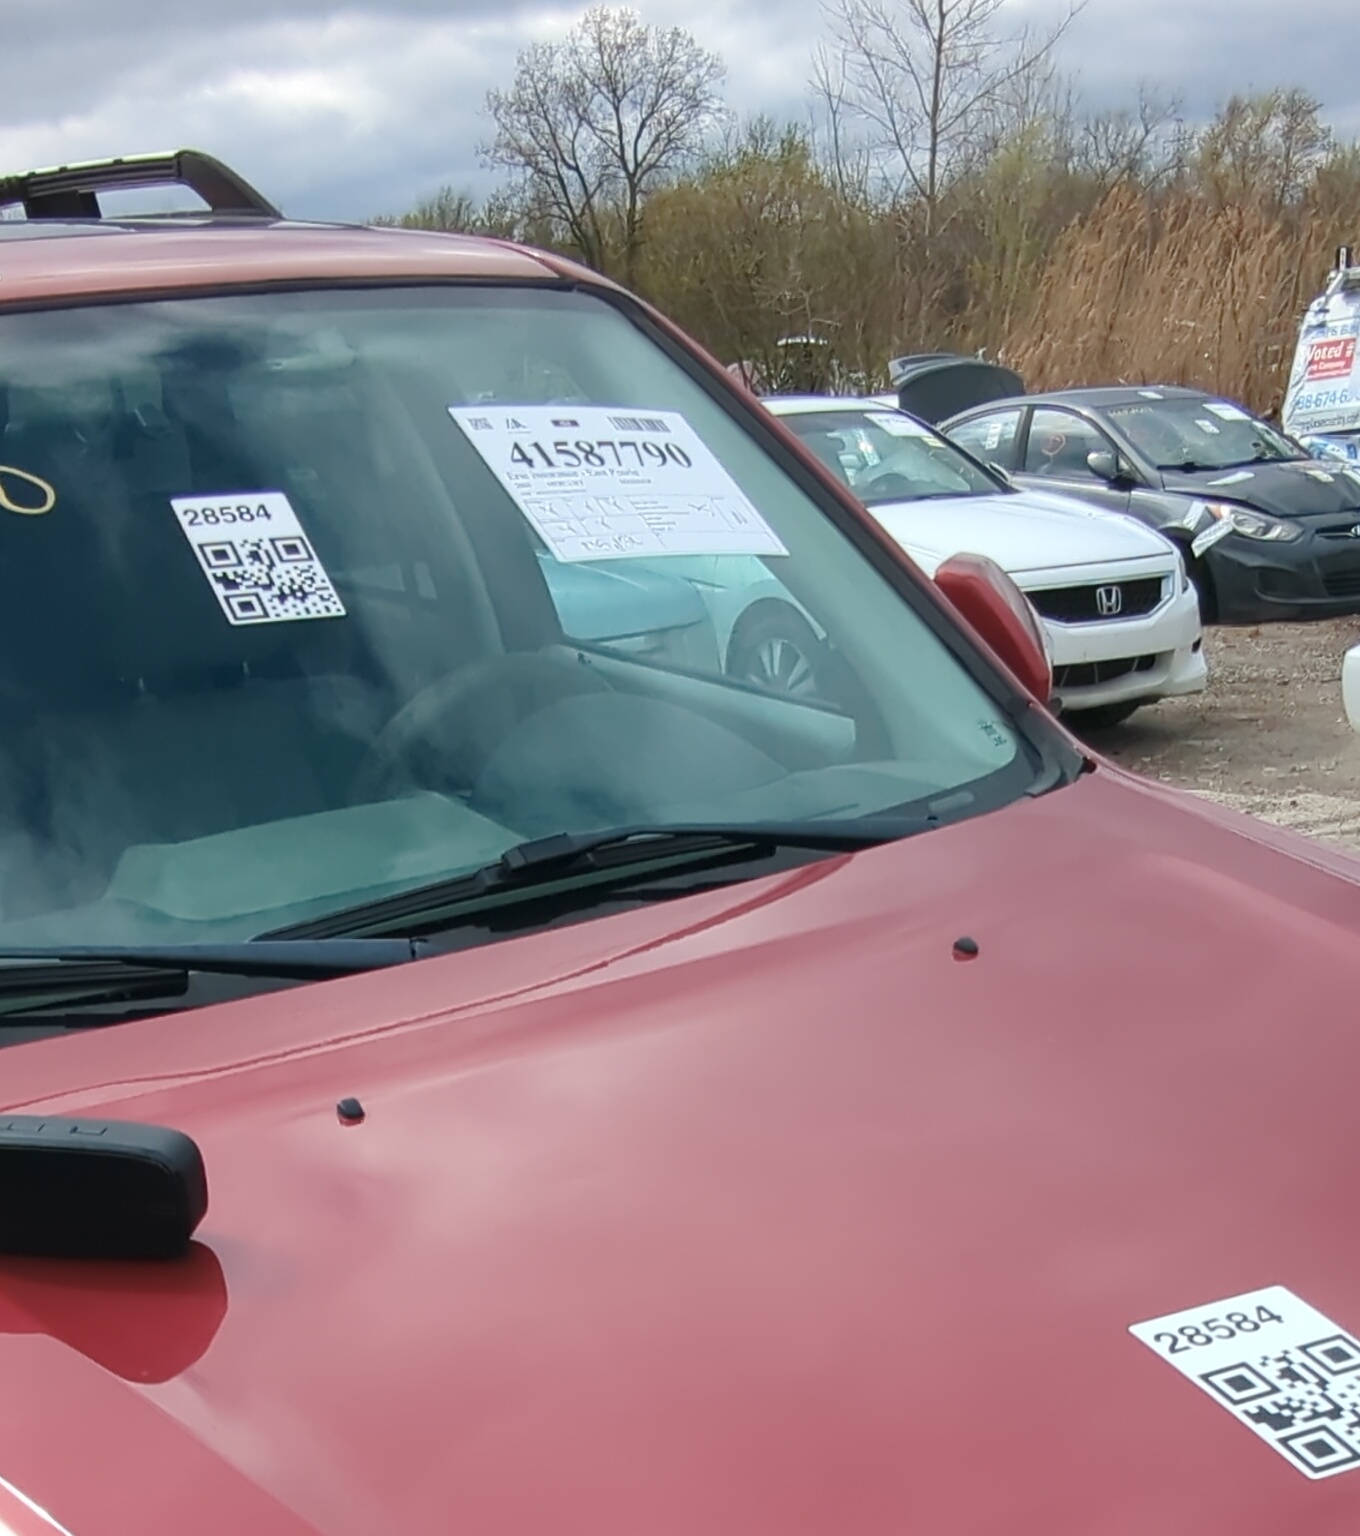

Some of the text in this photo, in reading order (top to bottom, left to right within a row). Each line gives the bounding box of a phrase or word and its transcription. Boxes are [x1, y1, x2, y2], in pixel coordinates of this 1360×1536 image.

[510, 441, 692, 468] 41587790
[183, 504, 272, 526] 28584
[1153, 1305, 1285, 1354] 28584
